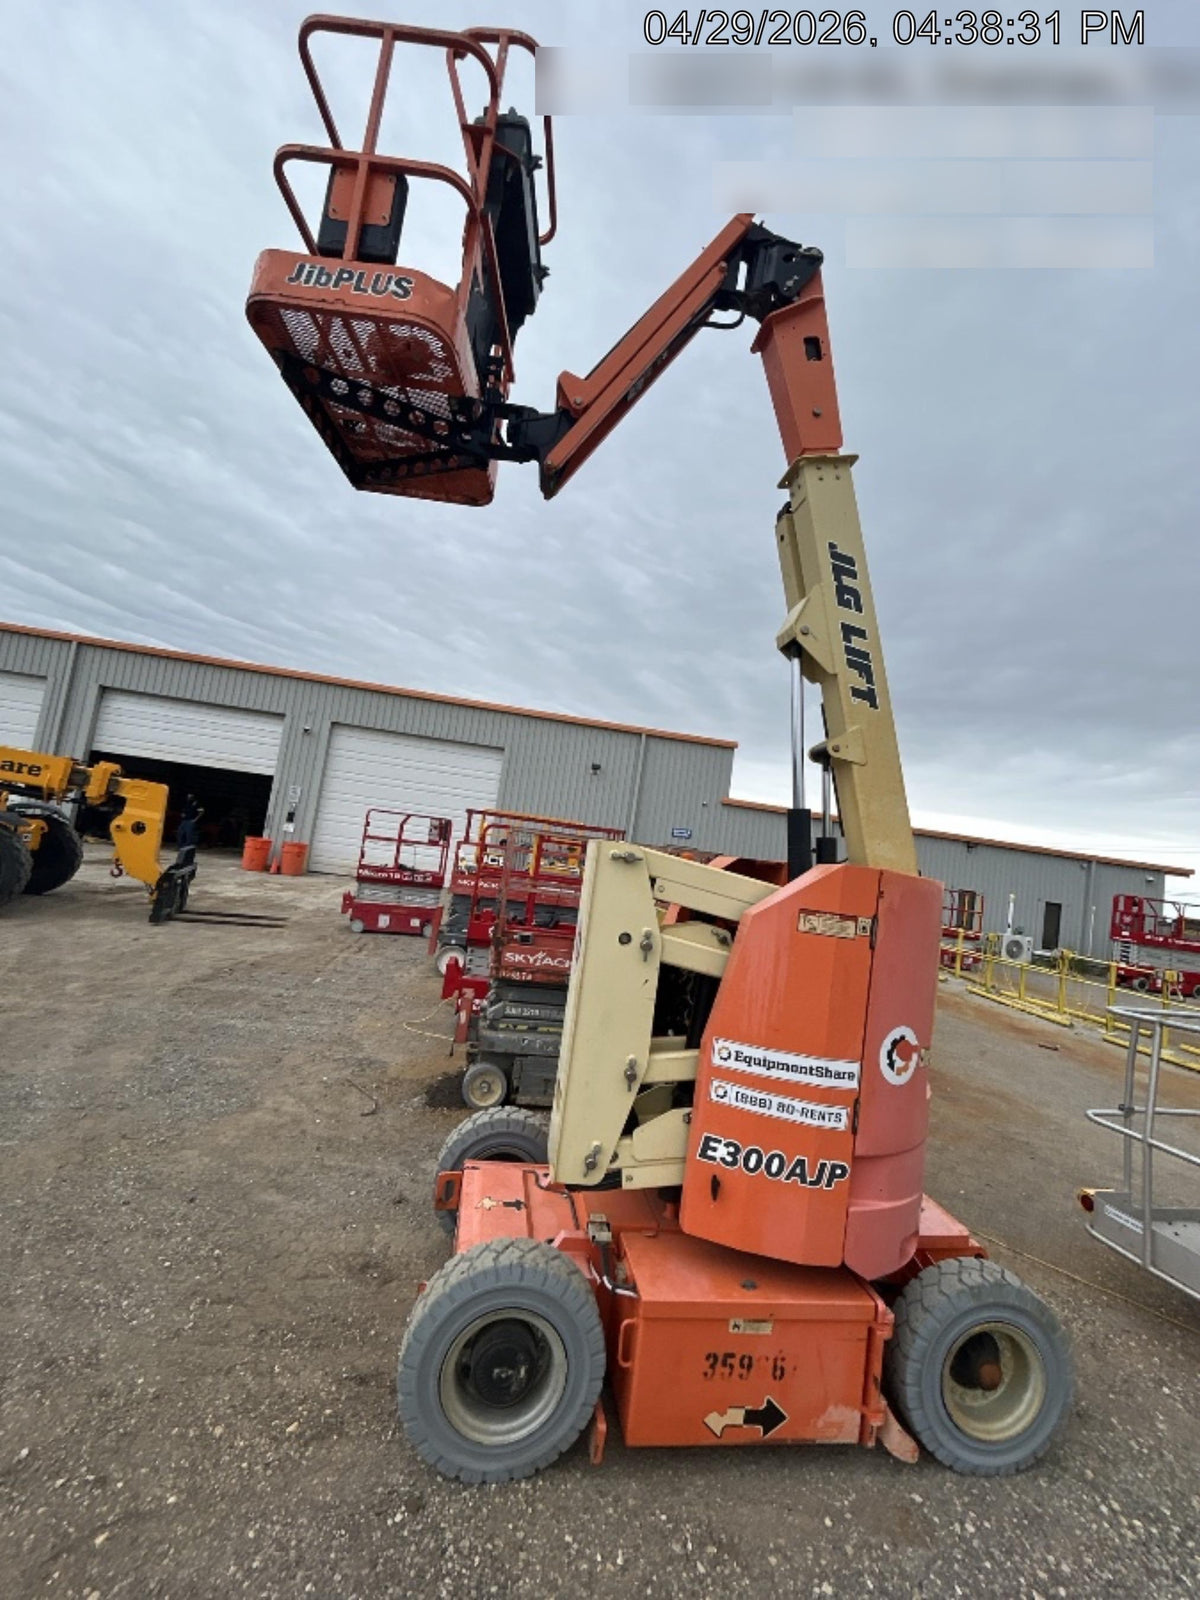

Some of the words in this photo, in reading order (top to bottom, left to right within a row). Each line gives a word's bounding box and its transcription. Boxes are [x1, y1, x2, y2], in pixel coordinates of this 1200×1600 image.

[287, 262, 415, 300] JibPLUS
[828, 541, 864, 616] JLG
[840, 621, 880, 711] LIFT
[0, 760, 42, 777] are
[733, 1049, 857, 1082] EquipmentShare
[734, 1091, 773, 1110] (888)
[776, 1101, 844, 1124] 80-RENTS
[697, 1133, 852, 1190] E300AJP
